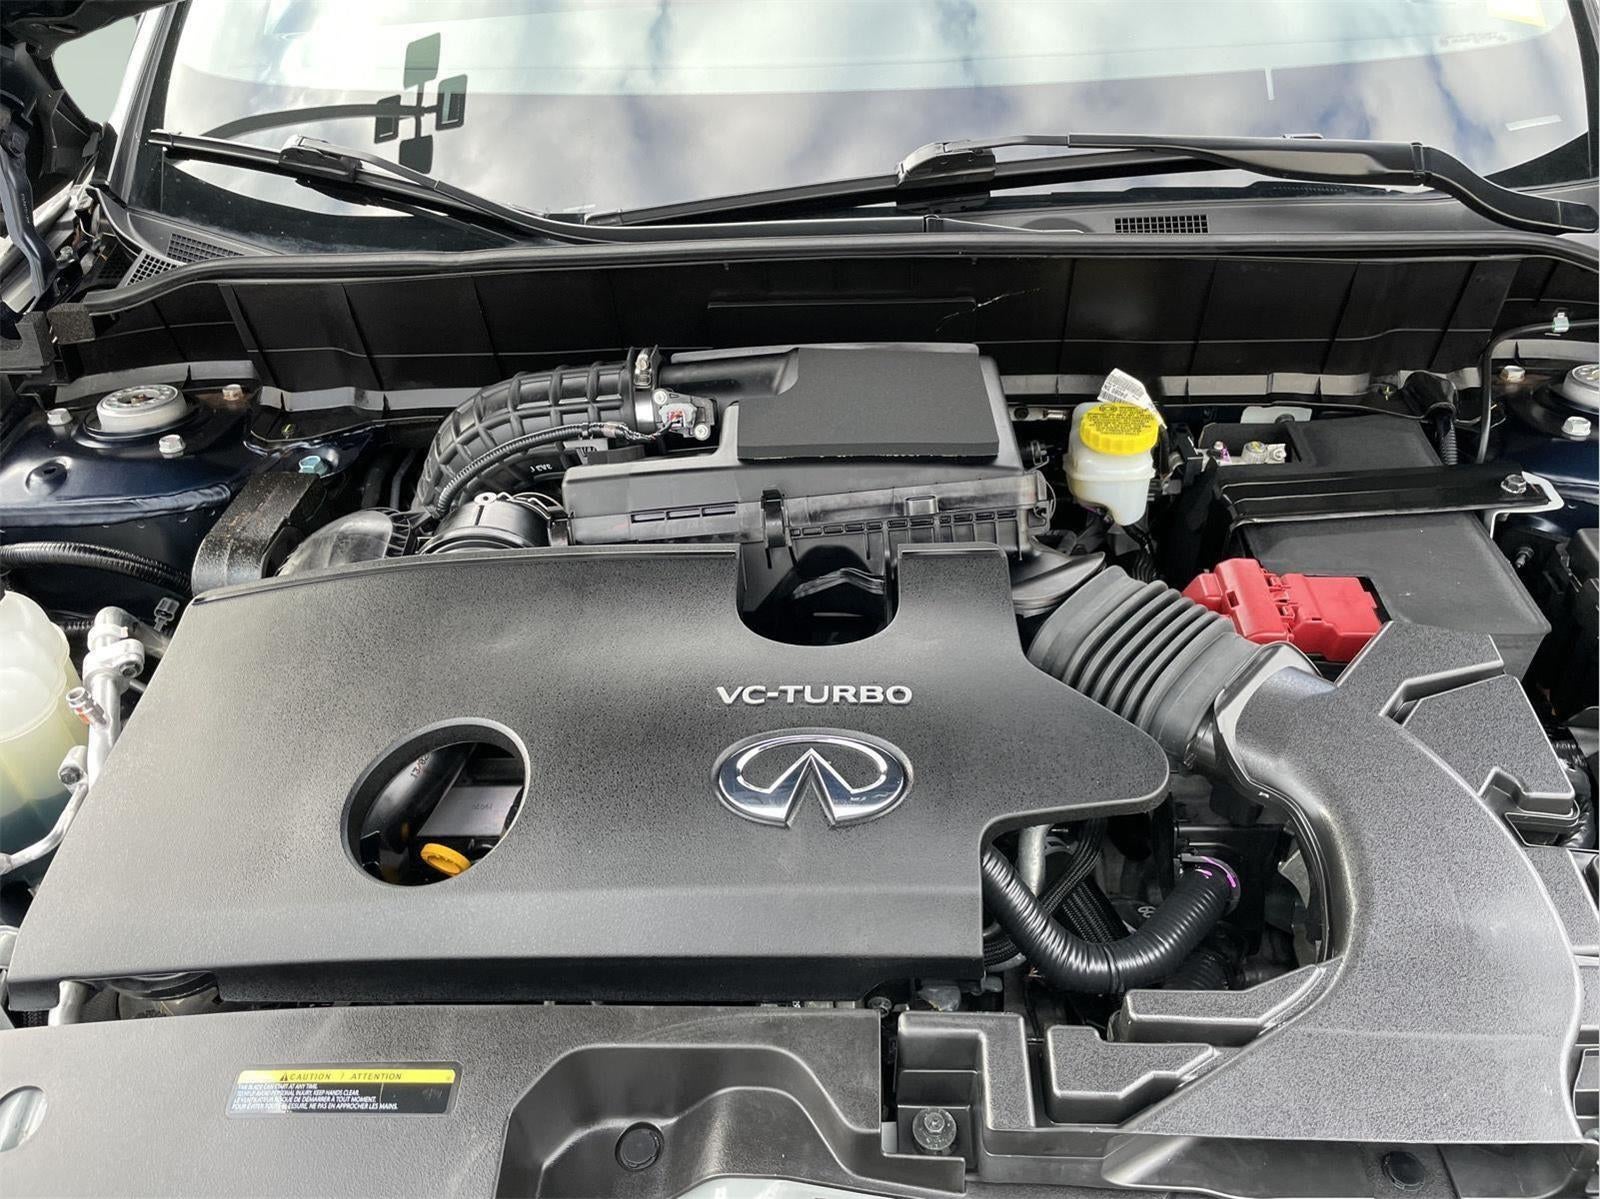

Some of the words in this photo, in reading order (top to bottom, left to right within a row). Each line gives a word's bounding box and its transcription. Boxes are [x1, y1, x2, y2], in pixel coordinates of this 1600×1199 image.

[716, 685, 913, 705] VC-TURBO
[289, 1072, 332, 1080] CAUTION
[351, 1072, 402, 1080] ATTENTION
